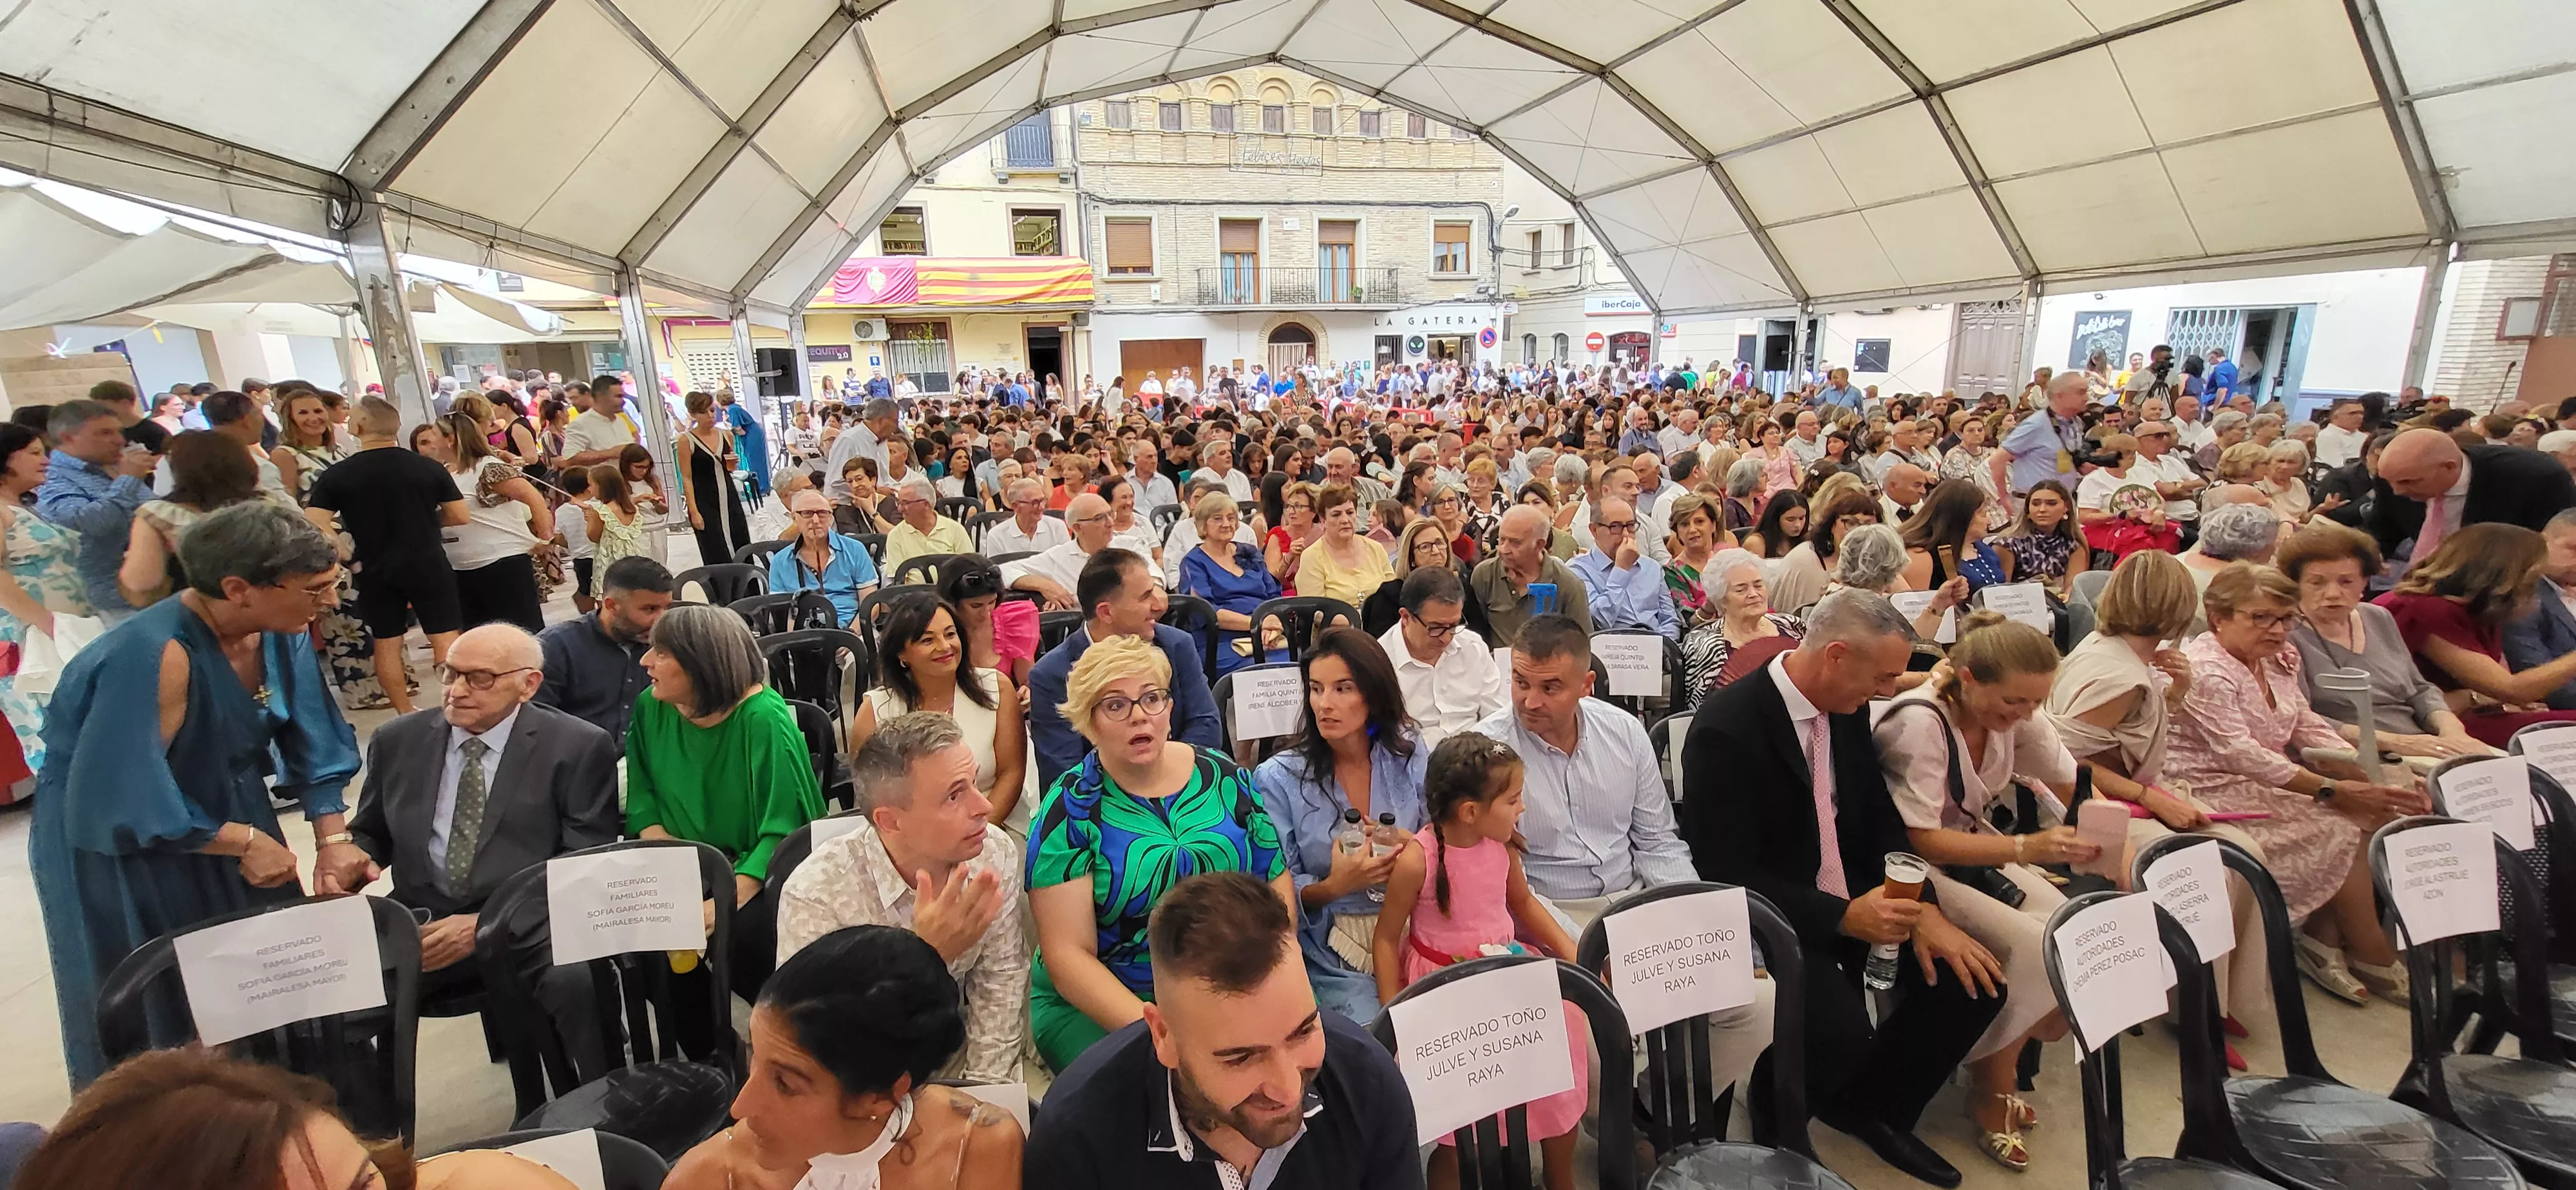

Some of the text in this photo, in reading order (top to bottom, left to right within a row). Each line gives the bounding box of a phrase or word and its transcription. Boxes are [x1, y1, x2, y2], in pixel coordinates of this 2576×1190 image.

[1374, 316, 1477, 326] LA GATERA
[1257, 679, 1296, 688] RESERVADO
[1267, 699, 1298, 707] ALCOBER
[2405, 842, 2452, 858] RESERVADO
[607, 876, 658, 889] RESERVADO
[610, 889, 658, 902] FAMILIARES
[592, 916, 645, 932] (MAIRALESA
[2074, 920, 2117, 949] RESERVADO
[256, 934, 322, 957] RESERVADO
[1623, 929, 1736, 967] RESERVADO TOÑO
[2076, 935, 2126, 967] AUTORIDADES
[263, 949, 325, 970] FAMILIARES
[1631, 949, 1732, 985] JULVE Y SUSANA
[2089, 958, 2113, 978] PEREZ
[2112, 947, 2146, 966] POSAC
[1664, 975, 1696, 994] RAYA
[1415, 1006, 1547, 1062] RESERVADO TOÑO
[1426, 1030, 1544, 1081] JULVE Y SUSANA
[1466, 1062, 1505, 1088] RAYA
